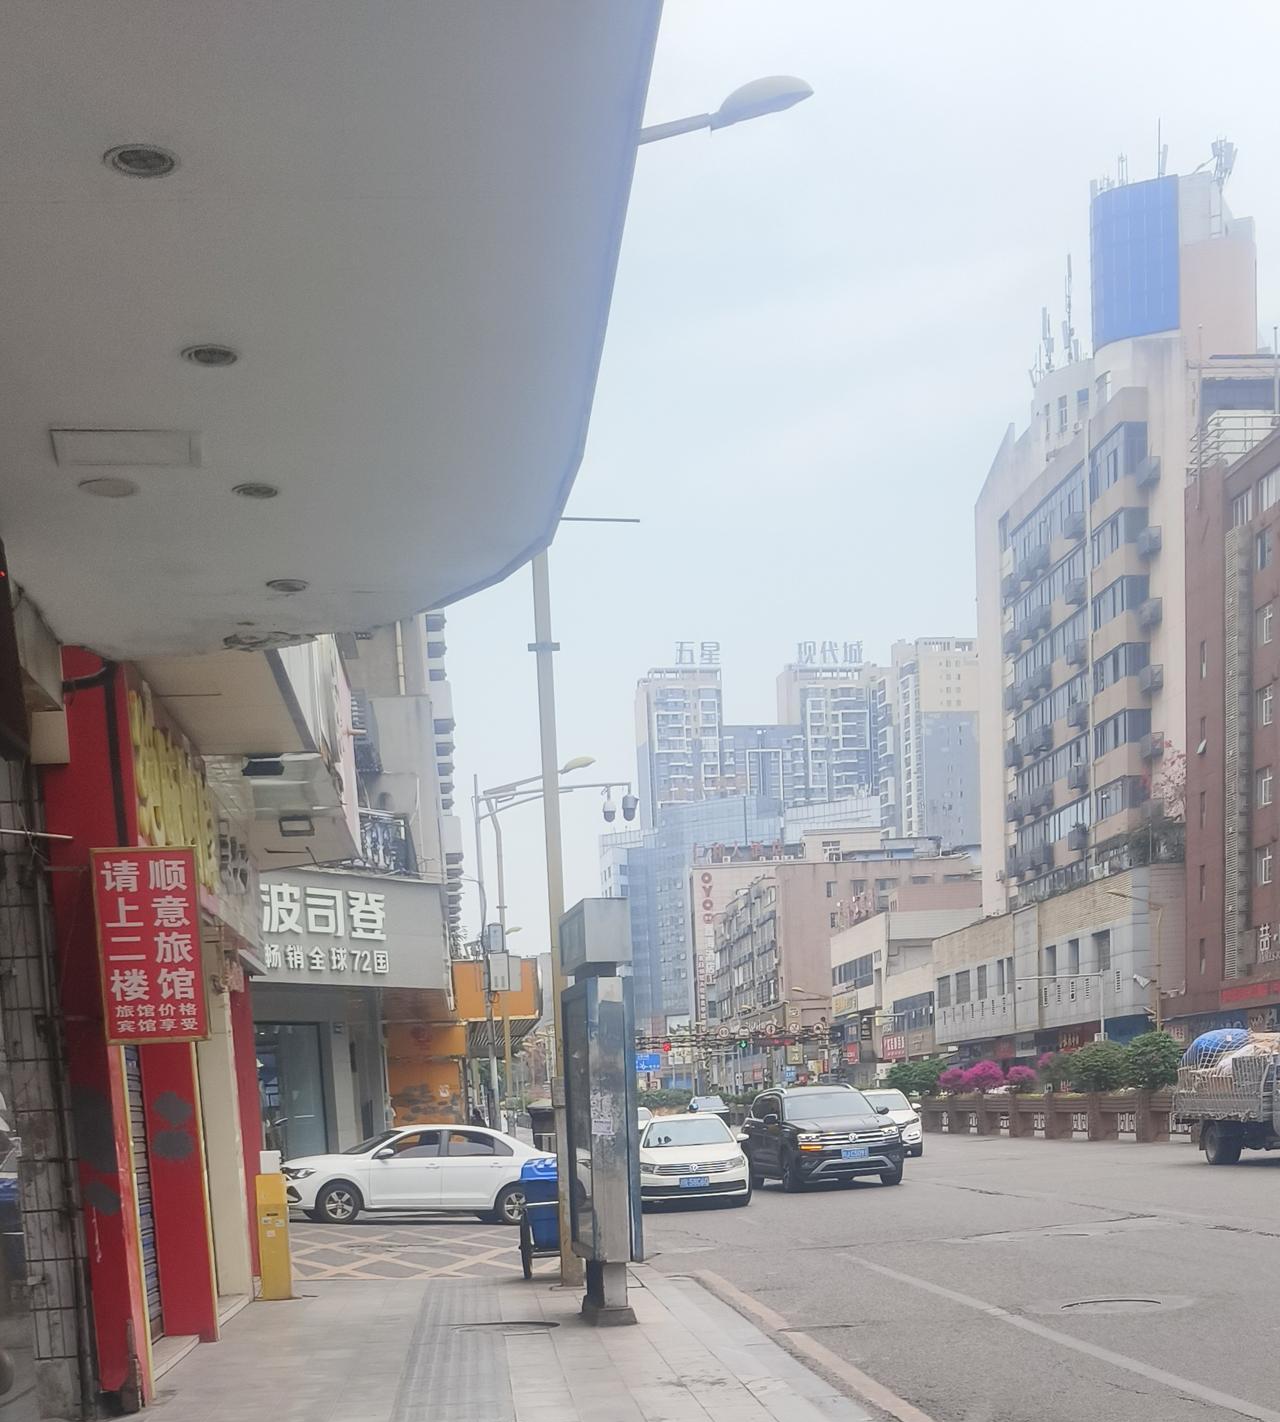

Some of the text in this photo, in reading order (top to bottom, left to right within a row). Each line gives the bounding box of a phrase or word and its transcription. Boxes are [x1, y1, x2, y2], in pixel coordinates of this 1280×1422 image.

[675, 640, 863, 665] 五星 现代城
[259, 882, 387, 940] 波司登
[101, 860, 150, 1001] 请上二楼
[149, 859, 195, 1000] 顺意旅馆
[264, 943, 389, 973] 畅销全球72国
[115, 1002, 197, 1018] 旅馆价格
[117, 1018, 198, 1033] 宾馆享受
